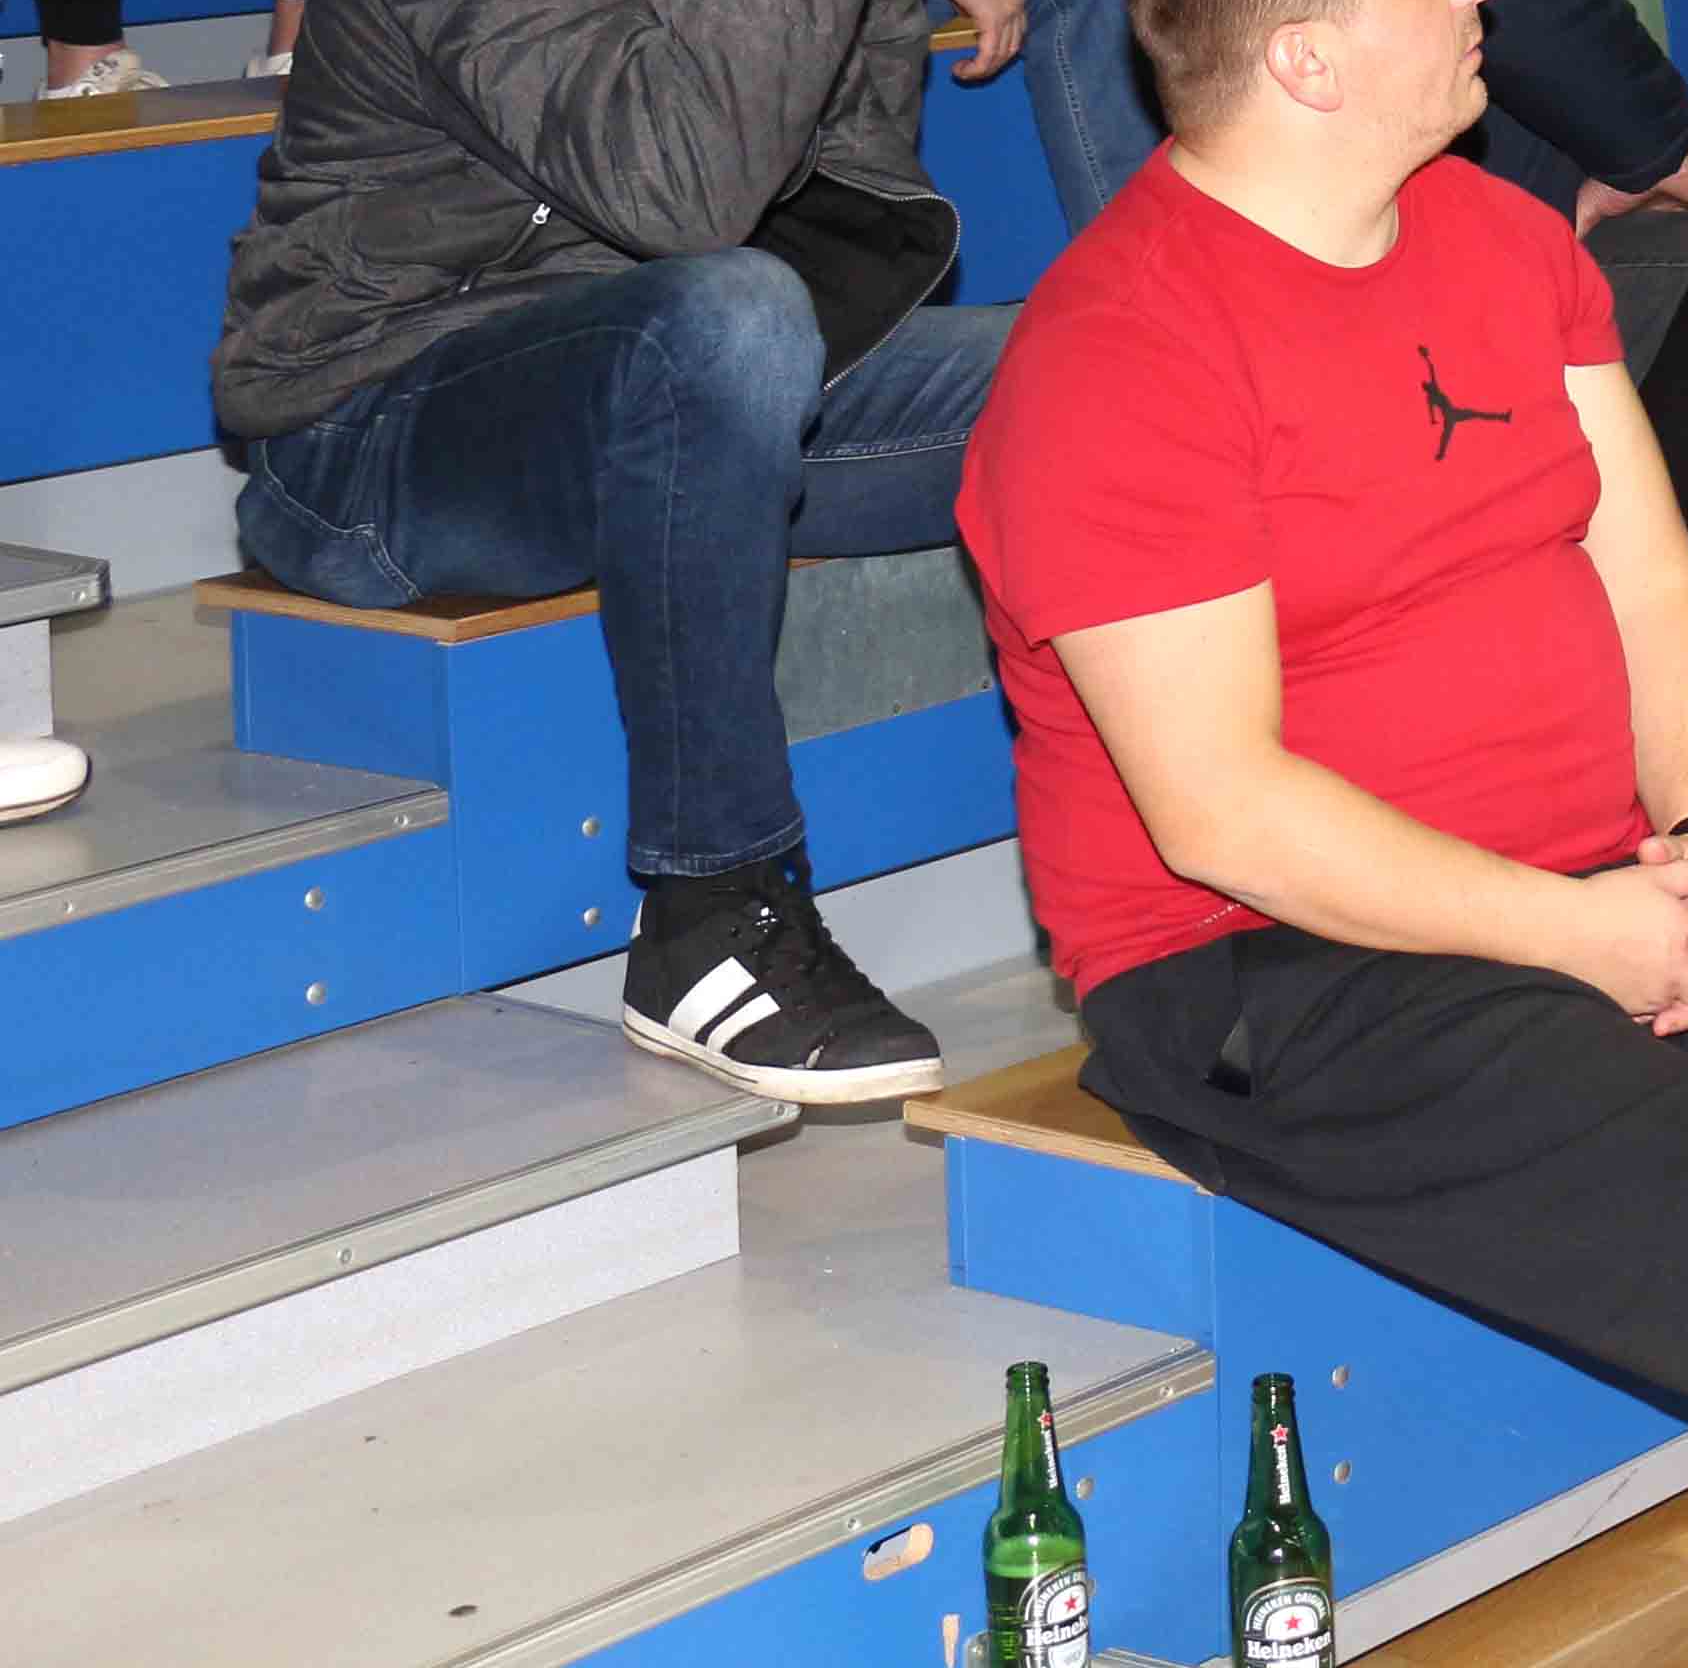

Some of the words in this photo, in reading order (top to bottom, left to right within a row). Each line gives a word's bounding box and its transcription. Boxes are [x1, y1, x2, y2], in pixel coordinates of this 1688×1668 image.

[1275, 1443, 1292, 1506] Heineken
[1025, 1614, 1089, 1646] Heinek
[1247, 1630, 1332, 1660] Heineken
